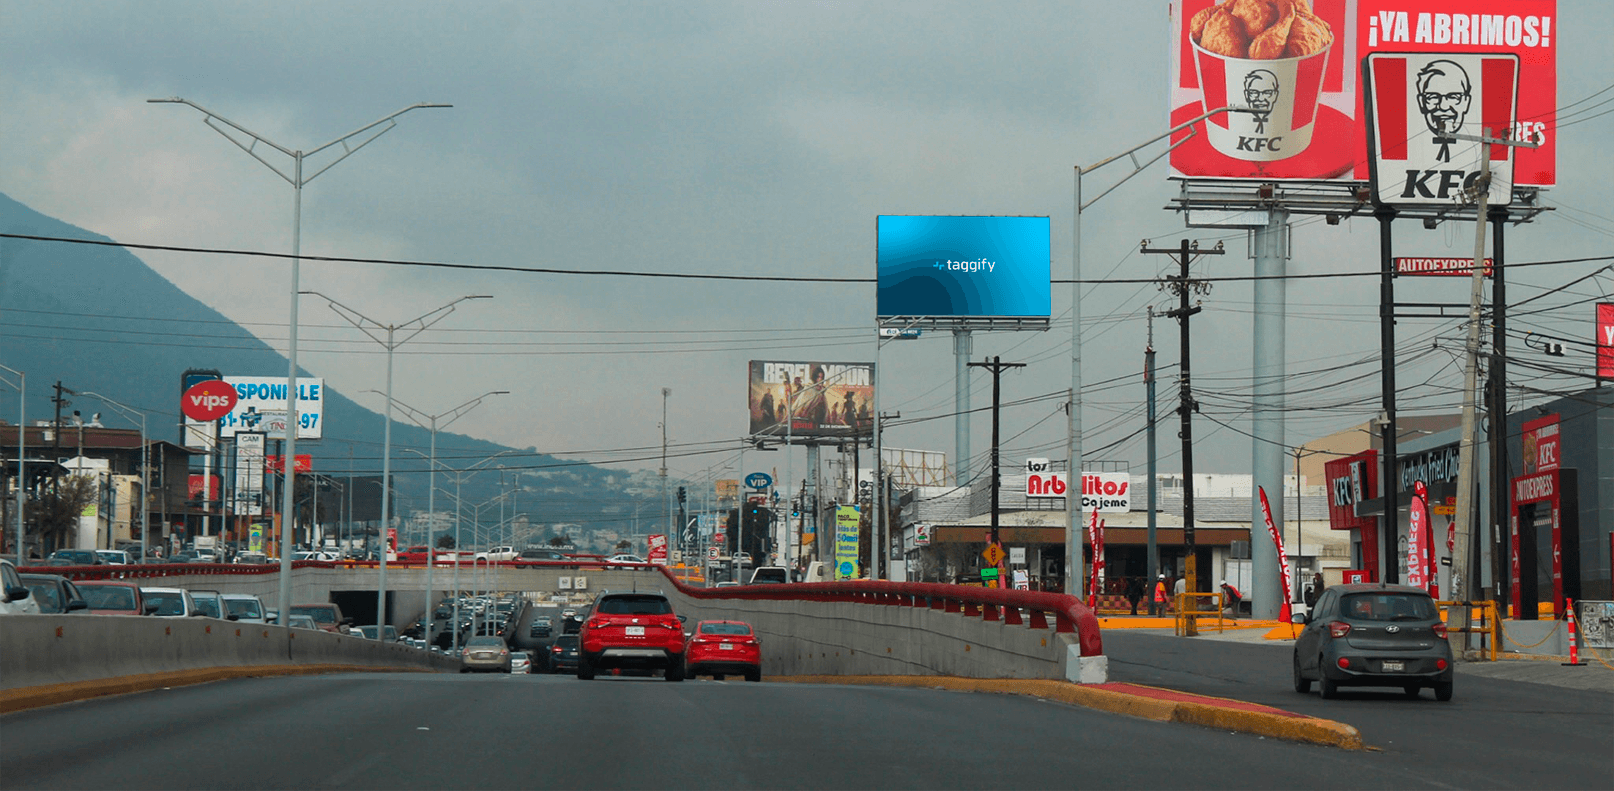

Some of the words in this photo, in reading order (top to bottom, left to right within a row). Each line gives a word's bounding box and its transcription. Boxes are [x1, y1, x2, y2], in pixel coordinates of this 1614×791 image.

[1368, 10, 1410, 47] ¡YA
[1415, 12, 1551, 48] ABRIMOS!
[1236, 135, 1283, 152] KFC
[946, 257, 996, 273] taggify
[1398, 258, 1490, 274] AUTOEXPRES
[190, 390, 229, 411] vips
[241, 435, 260, 443] CAM
[1539, 441, 1556, 466] KFC
[1028, 460, 1047, 472] Los
[1428, 452, 1444, 486] Fried
[750, 478, 768, 487] VIP
[1028, 474, 1128, 496] Arblitos
[1332, 476, 1352, 507] KFC
[1516, 474, 1553, 502] AUTOEXPRESS
[1081, 497, 1127, 510] Cajeme
